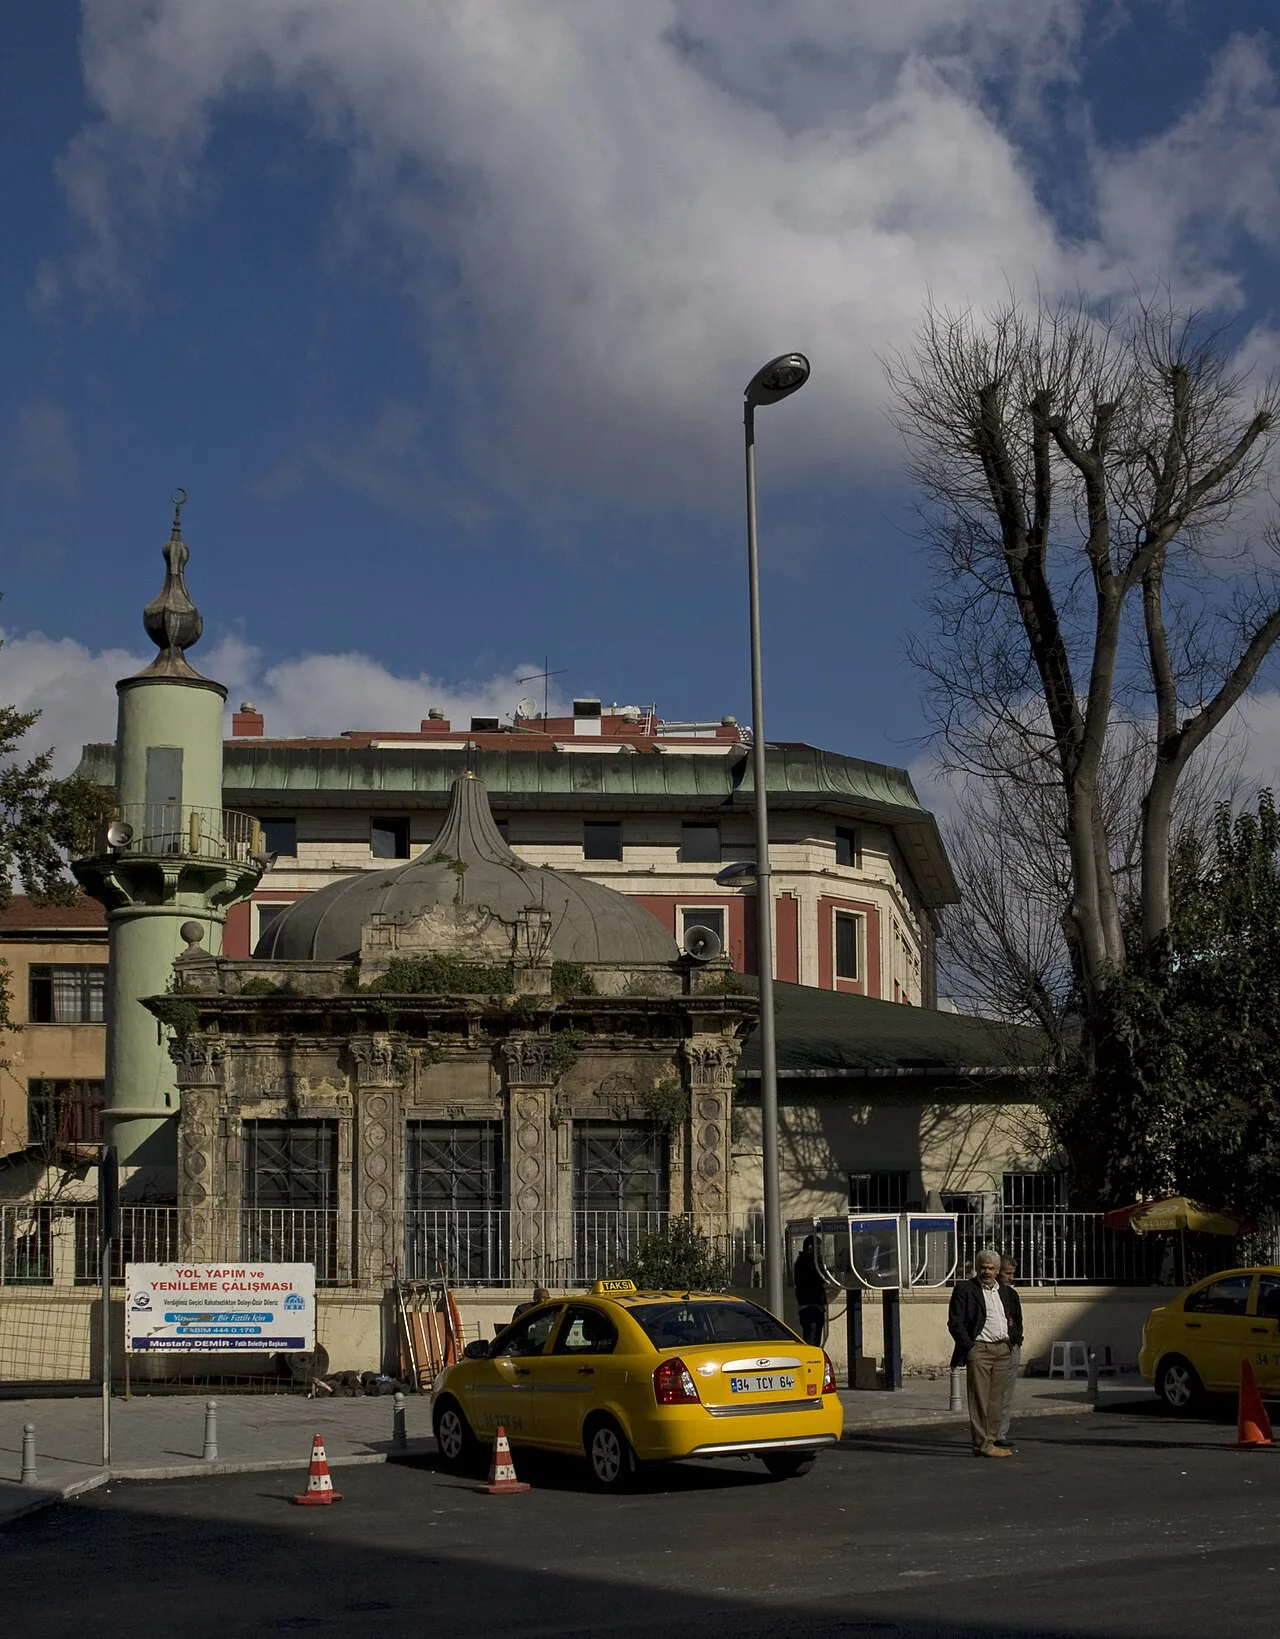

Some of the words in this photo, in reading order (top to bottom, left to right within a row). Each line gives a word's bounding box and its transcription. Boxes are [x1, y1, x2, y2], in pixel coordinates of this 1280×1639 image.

[176, 1270, 201, 1278] YOL
[205, 1270, 246, 1278] YAPIM
[150, 1280, 217, 1291] YENİLEME
[222, 1282, 293, 1292] ÇALIŞMASI
[164, 1299, 187, 1307] Verdiğimiz
[188, 1299, 203, 1307] Geçici
[252, 1314, 266, 1322] İçin
[248, 1340, 268, 1348] Belediye
[269, 1340, 288, 1348] Başkanı
[1256, 1352, 1268, 1366] 34
[737, 1379, 749, 1391] 34
[756, 1377, 773, 1389] TCY
[780, 1376, 791, 1388] 64
